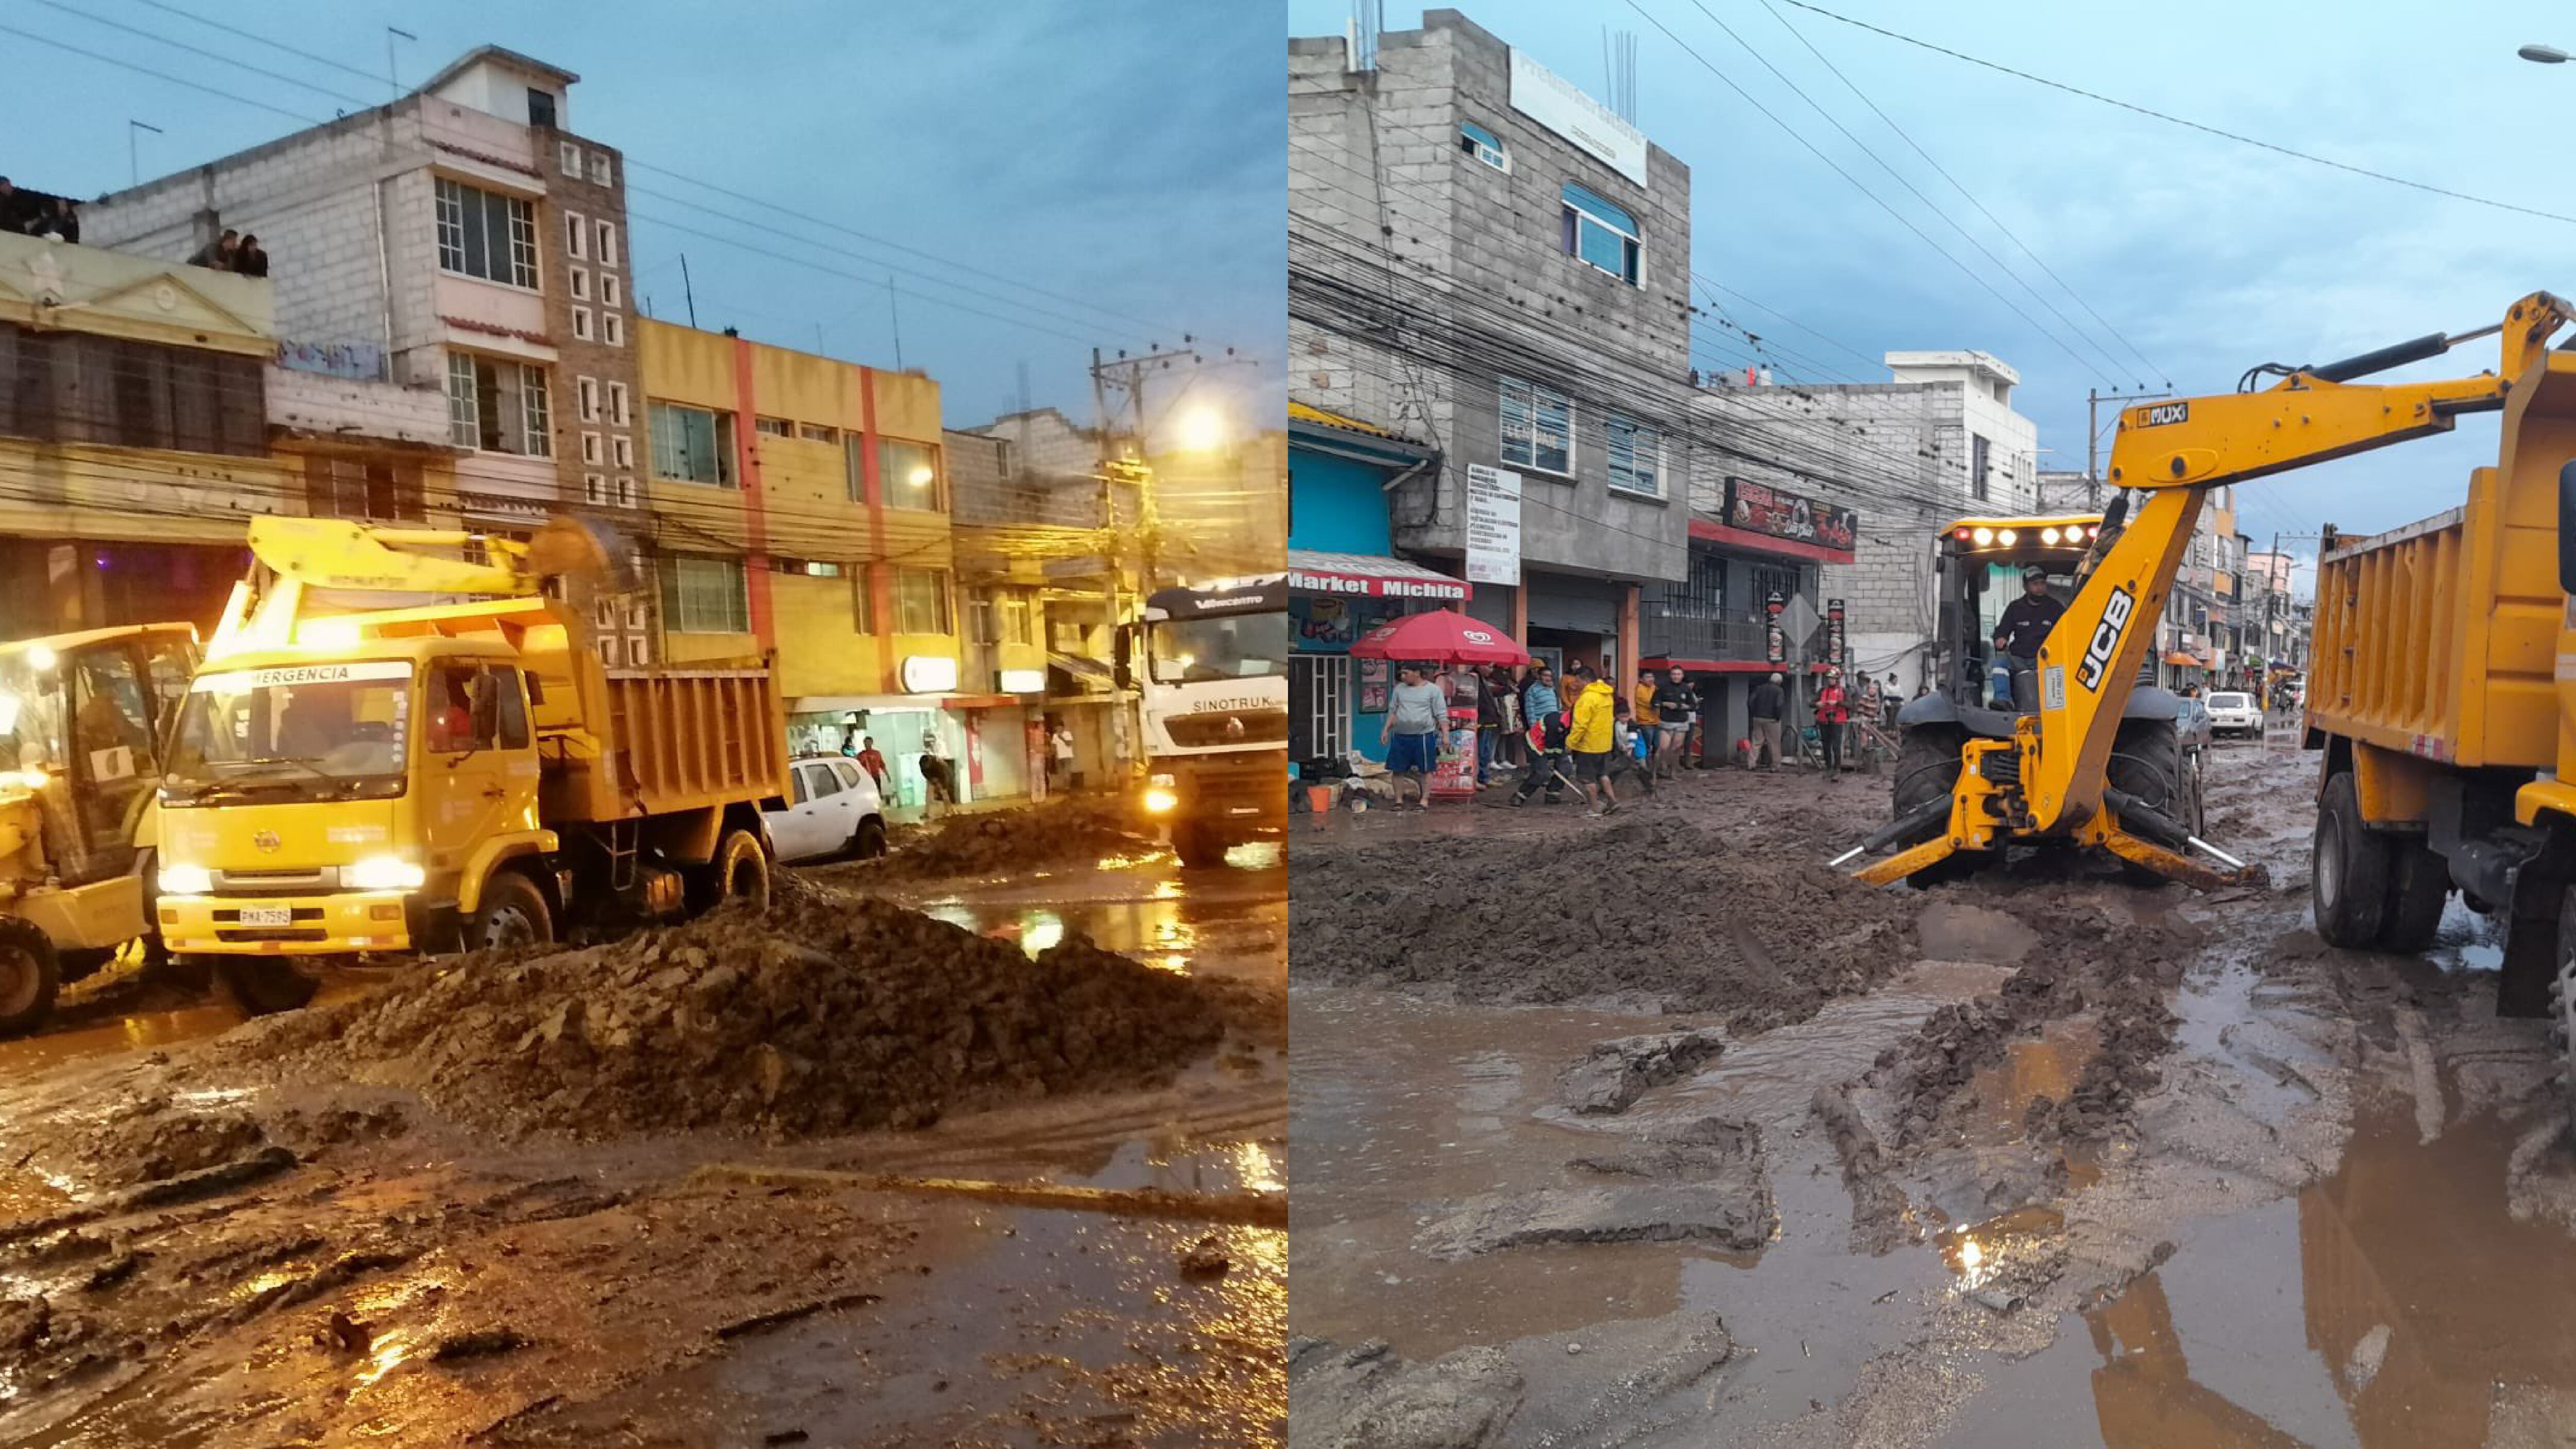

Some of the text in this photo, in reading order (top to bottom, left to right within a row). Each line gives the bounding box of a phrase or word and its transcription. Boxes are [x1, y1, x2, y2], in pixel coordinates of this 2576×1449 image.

[1288, 572, 1464, 598] Market Michita
[2084, 589, 2132, 689] JCB
[1194, 696, 1271, 712] SINOTRUK
